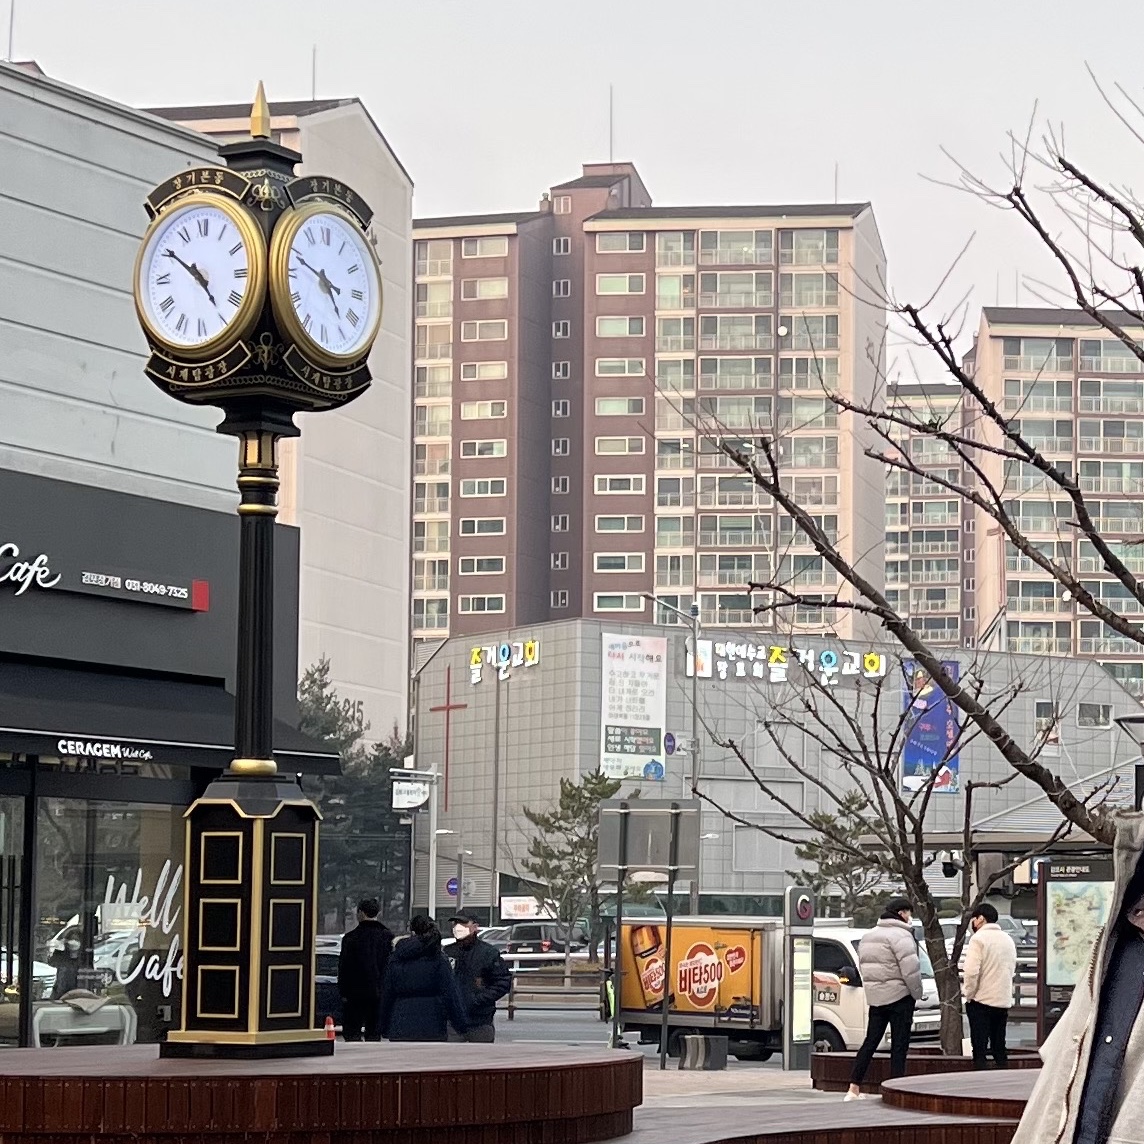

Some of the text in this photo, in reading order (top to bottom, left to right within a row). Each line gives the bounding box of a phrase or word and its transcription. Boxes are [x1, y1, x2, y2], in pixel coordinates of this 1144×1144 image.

[469, 640, 540, 684] 즐거운교회
[768, 645, 887, 687] 즐거운교회
[57, 739, 122, 758] CERAGEM
[104, 859, 184, 935] Well
[679, 960, 723, 995] 비타500
